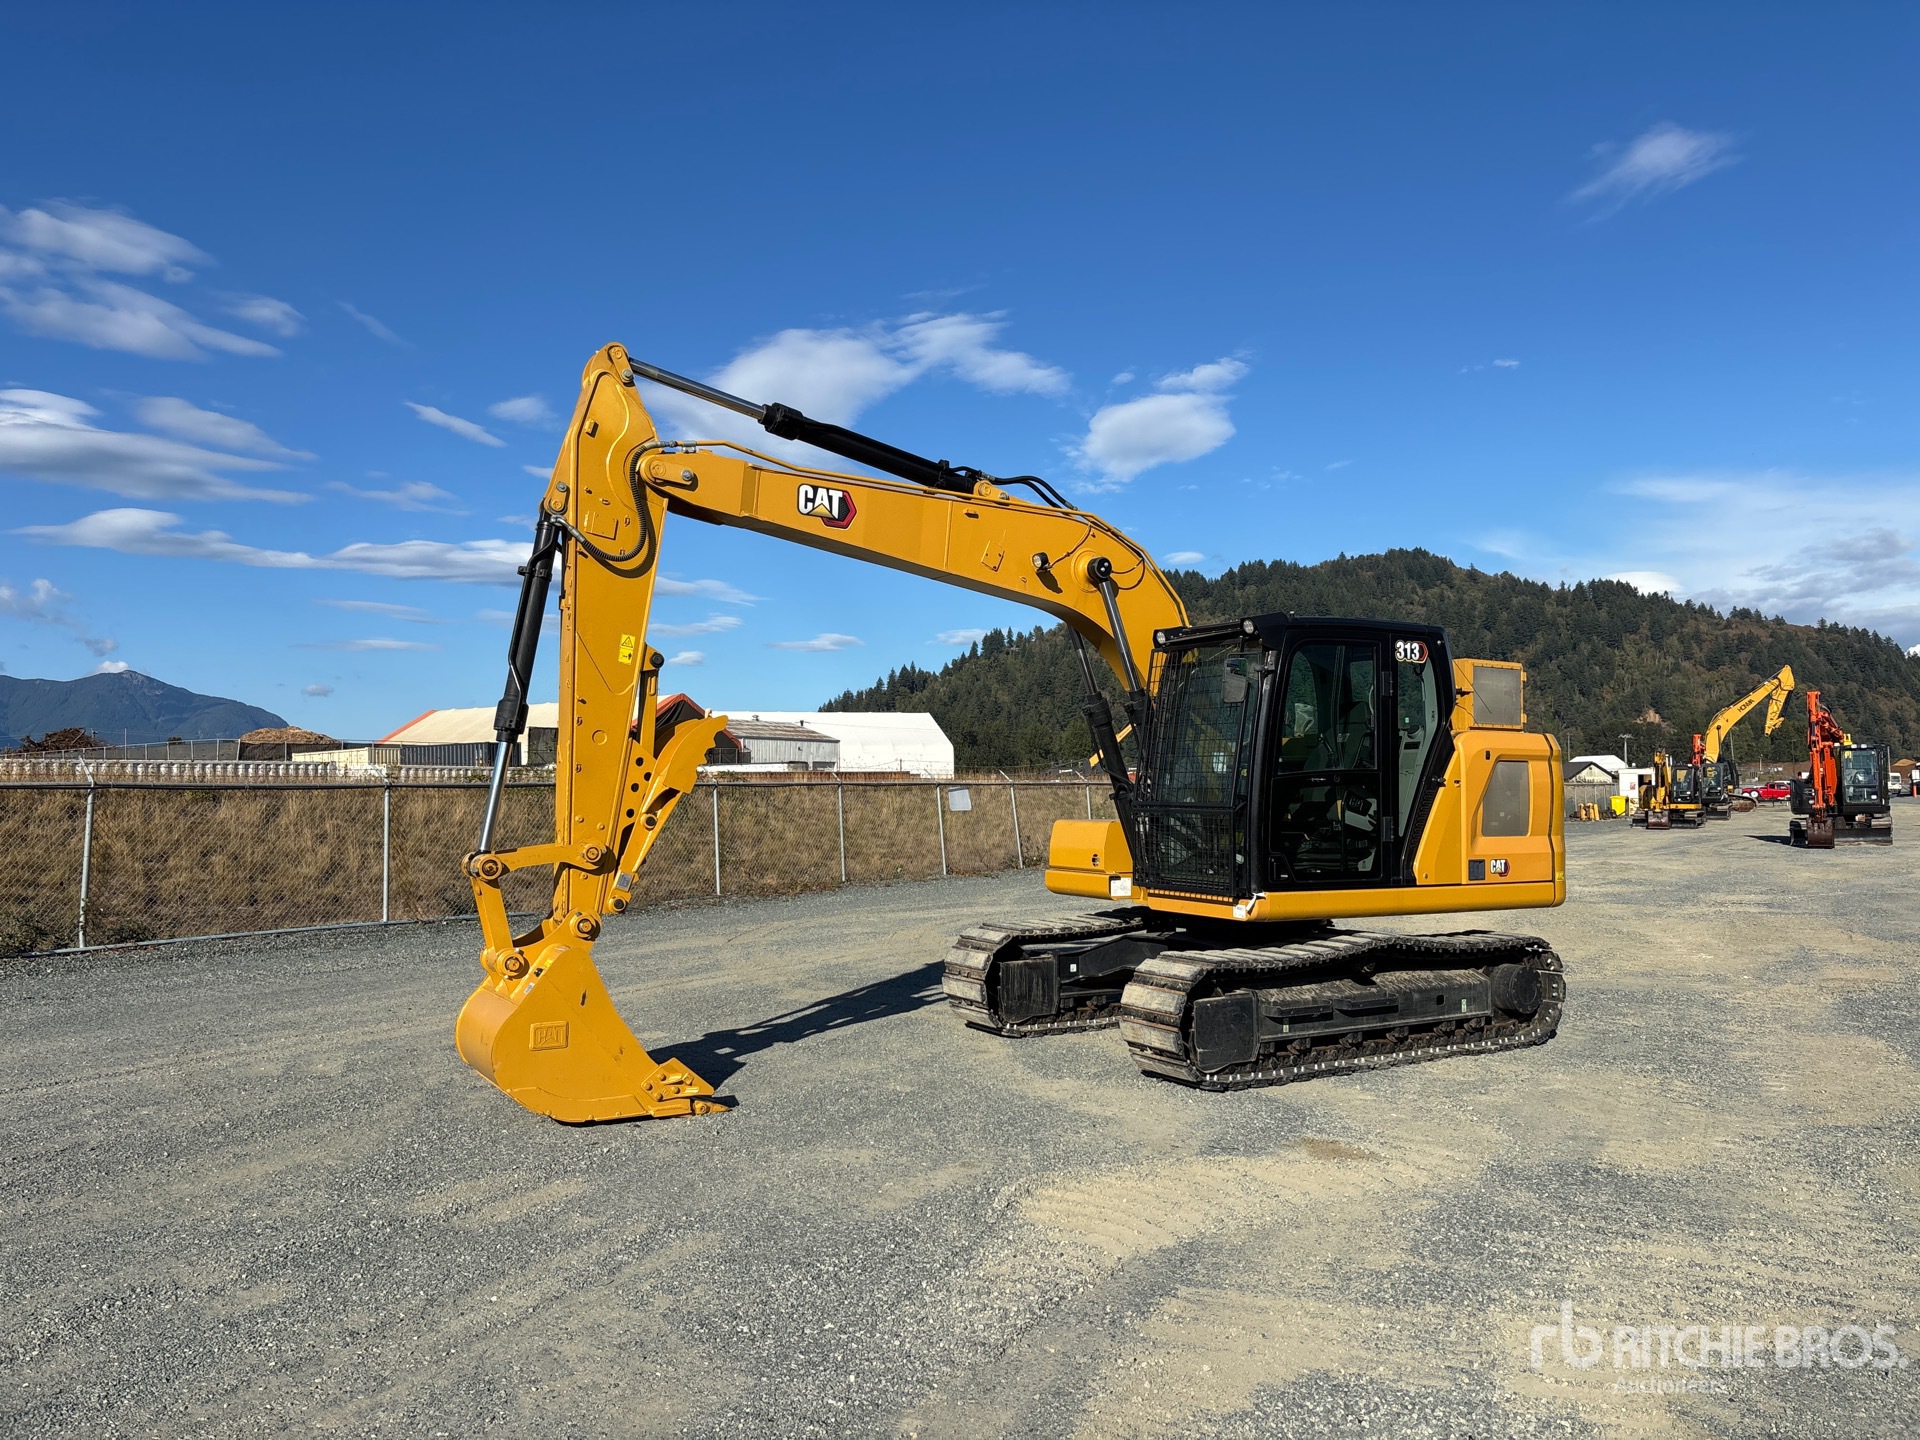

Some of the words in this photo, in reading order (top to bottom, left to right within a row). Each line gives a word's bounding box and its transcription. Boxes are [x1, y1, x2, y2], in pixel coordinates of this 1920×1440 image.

[798, 484, 843, 519] CAT
[1396, 641, 1419, 661] 313
[1490, 859, 1506, 874] CAT
[534, 1025, 566, 1048] CAT
